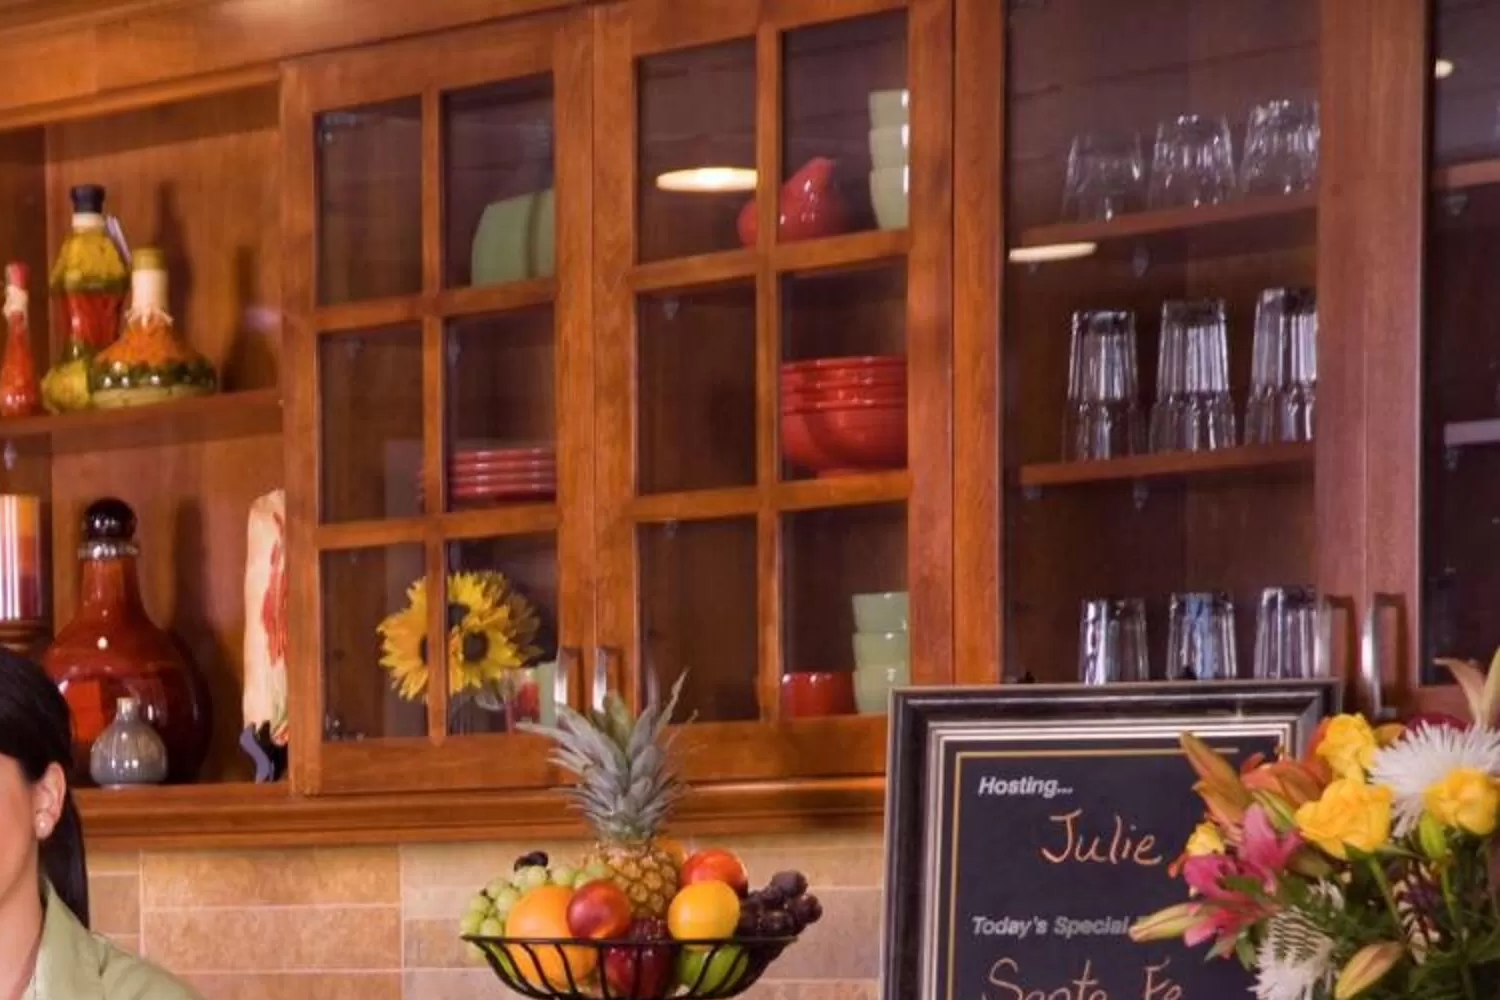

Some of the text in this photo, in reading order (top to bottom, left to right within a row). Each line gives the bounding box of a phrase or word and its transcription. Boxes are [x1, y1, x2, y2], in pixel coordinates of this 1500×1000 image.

[1041, 808, 1163, 865] Julie
[971, 916, 1048, 939] Today's
[1053, 916, 1131, 939] Special
